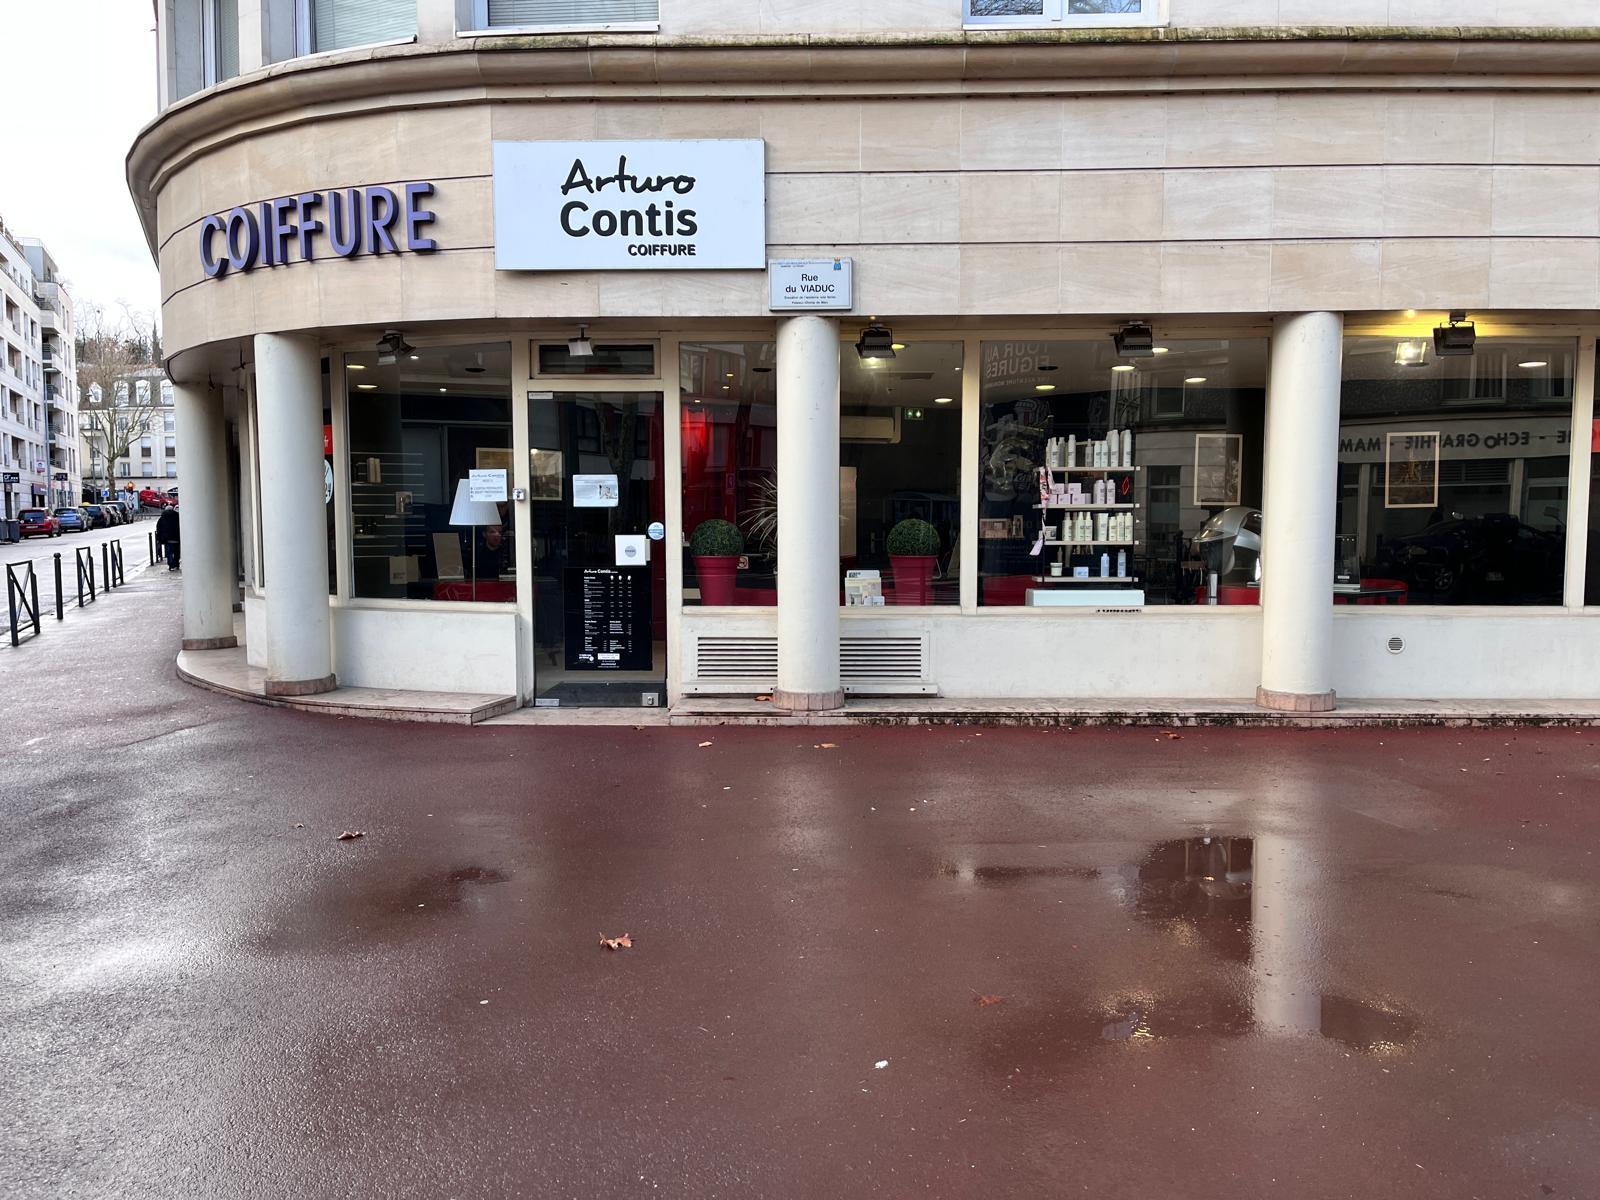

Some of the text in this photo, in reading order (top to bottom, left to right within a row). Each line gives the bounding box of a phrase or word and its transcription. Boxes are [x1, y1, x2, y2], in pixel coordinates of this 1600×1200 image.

[560, 154, 696, 196] Arturo
[199, 181, 437, 278] COIFFURE
[560, 200, 698, 238] Contis
[627, 243, 697, 256] COIFFURE
[785, 284, 835, 293] du VIADUC
[801, 273, 819, 282] Rue
